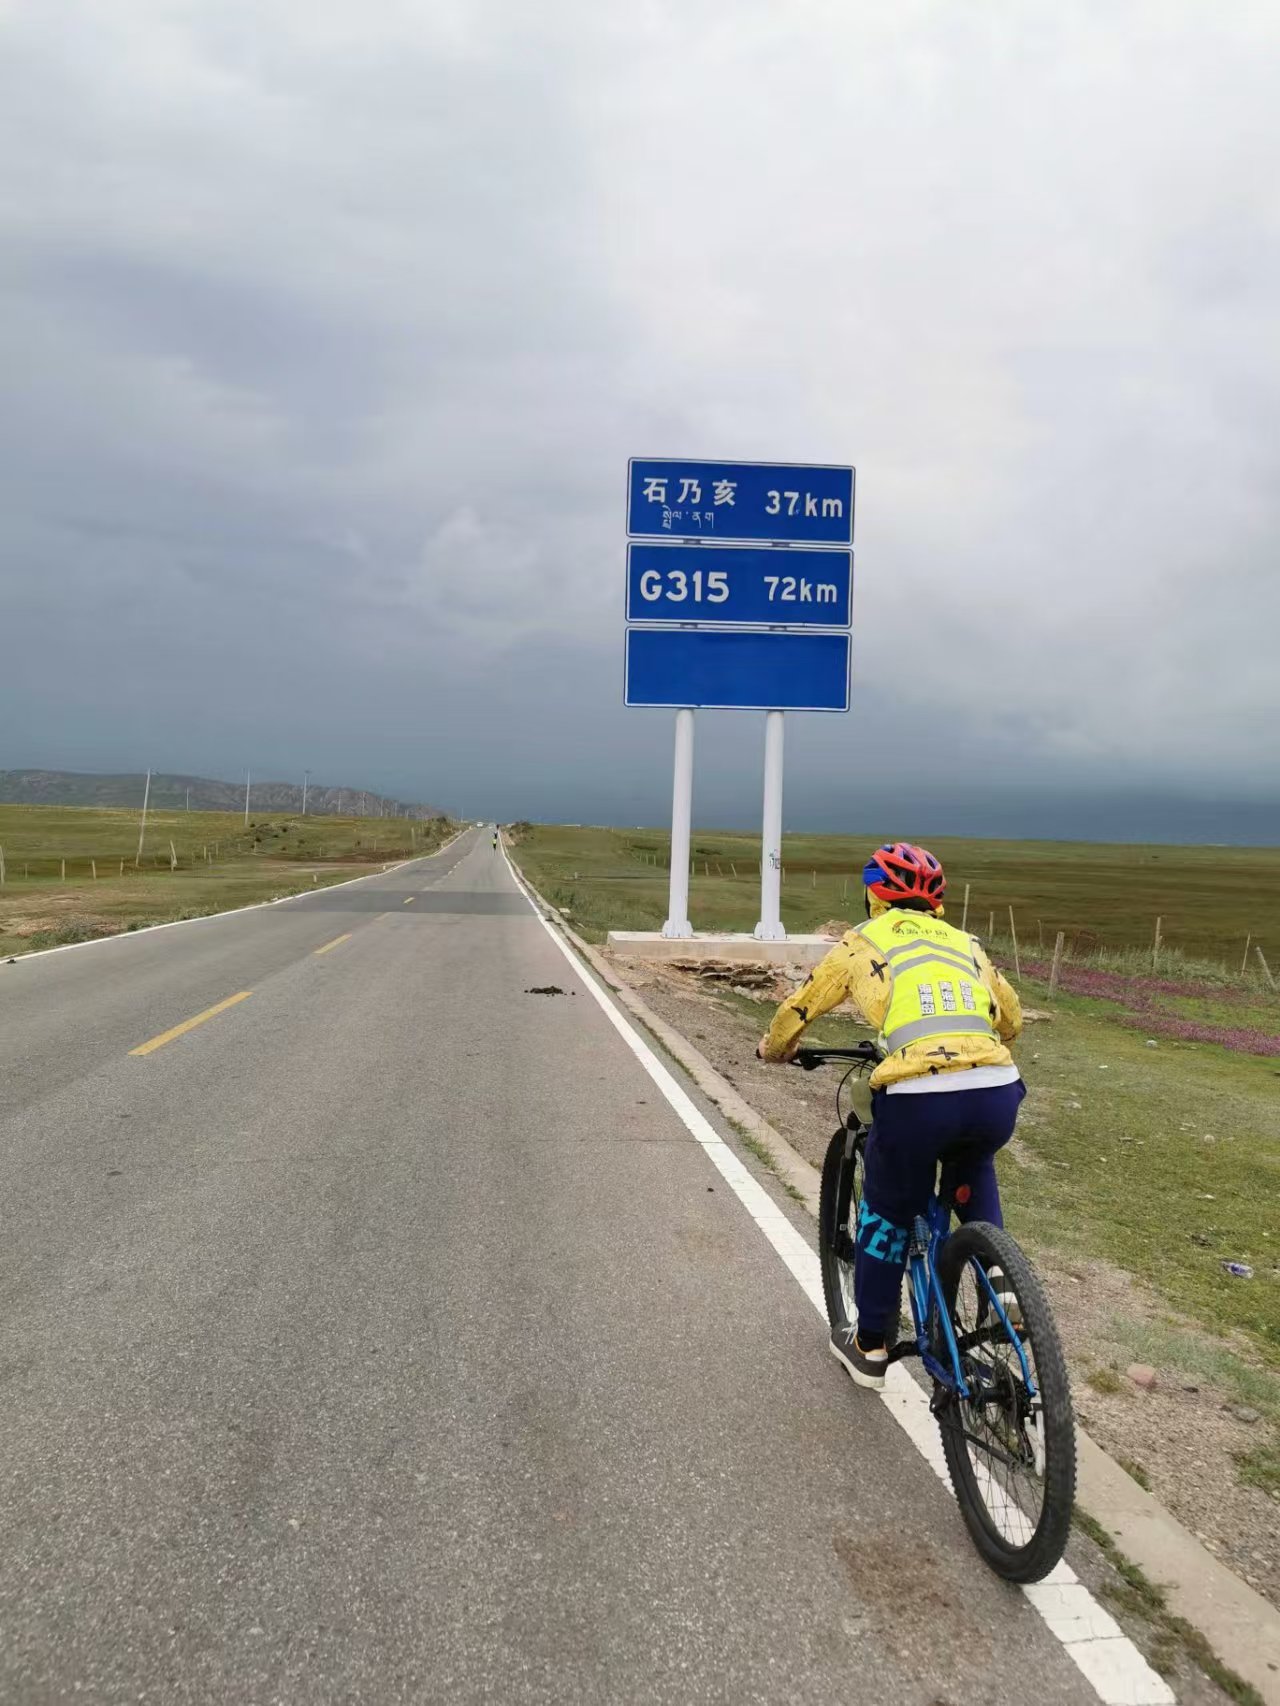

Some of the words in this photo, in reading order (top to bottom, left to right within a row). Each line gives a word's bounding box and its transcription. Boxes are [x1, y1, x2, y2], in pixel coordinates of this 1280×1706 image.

[642, 477, 738, 506] 石乃亥
[765, 490, 844, 518] 37km
[640, 570, 730, 603] G315
[763, 576, 838, 603] 72km
